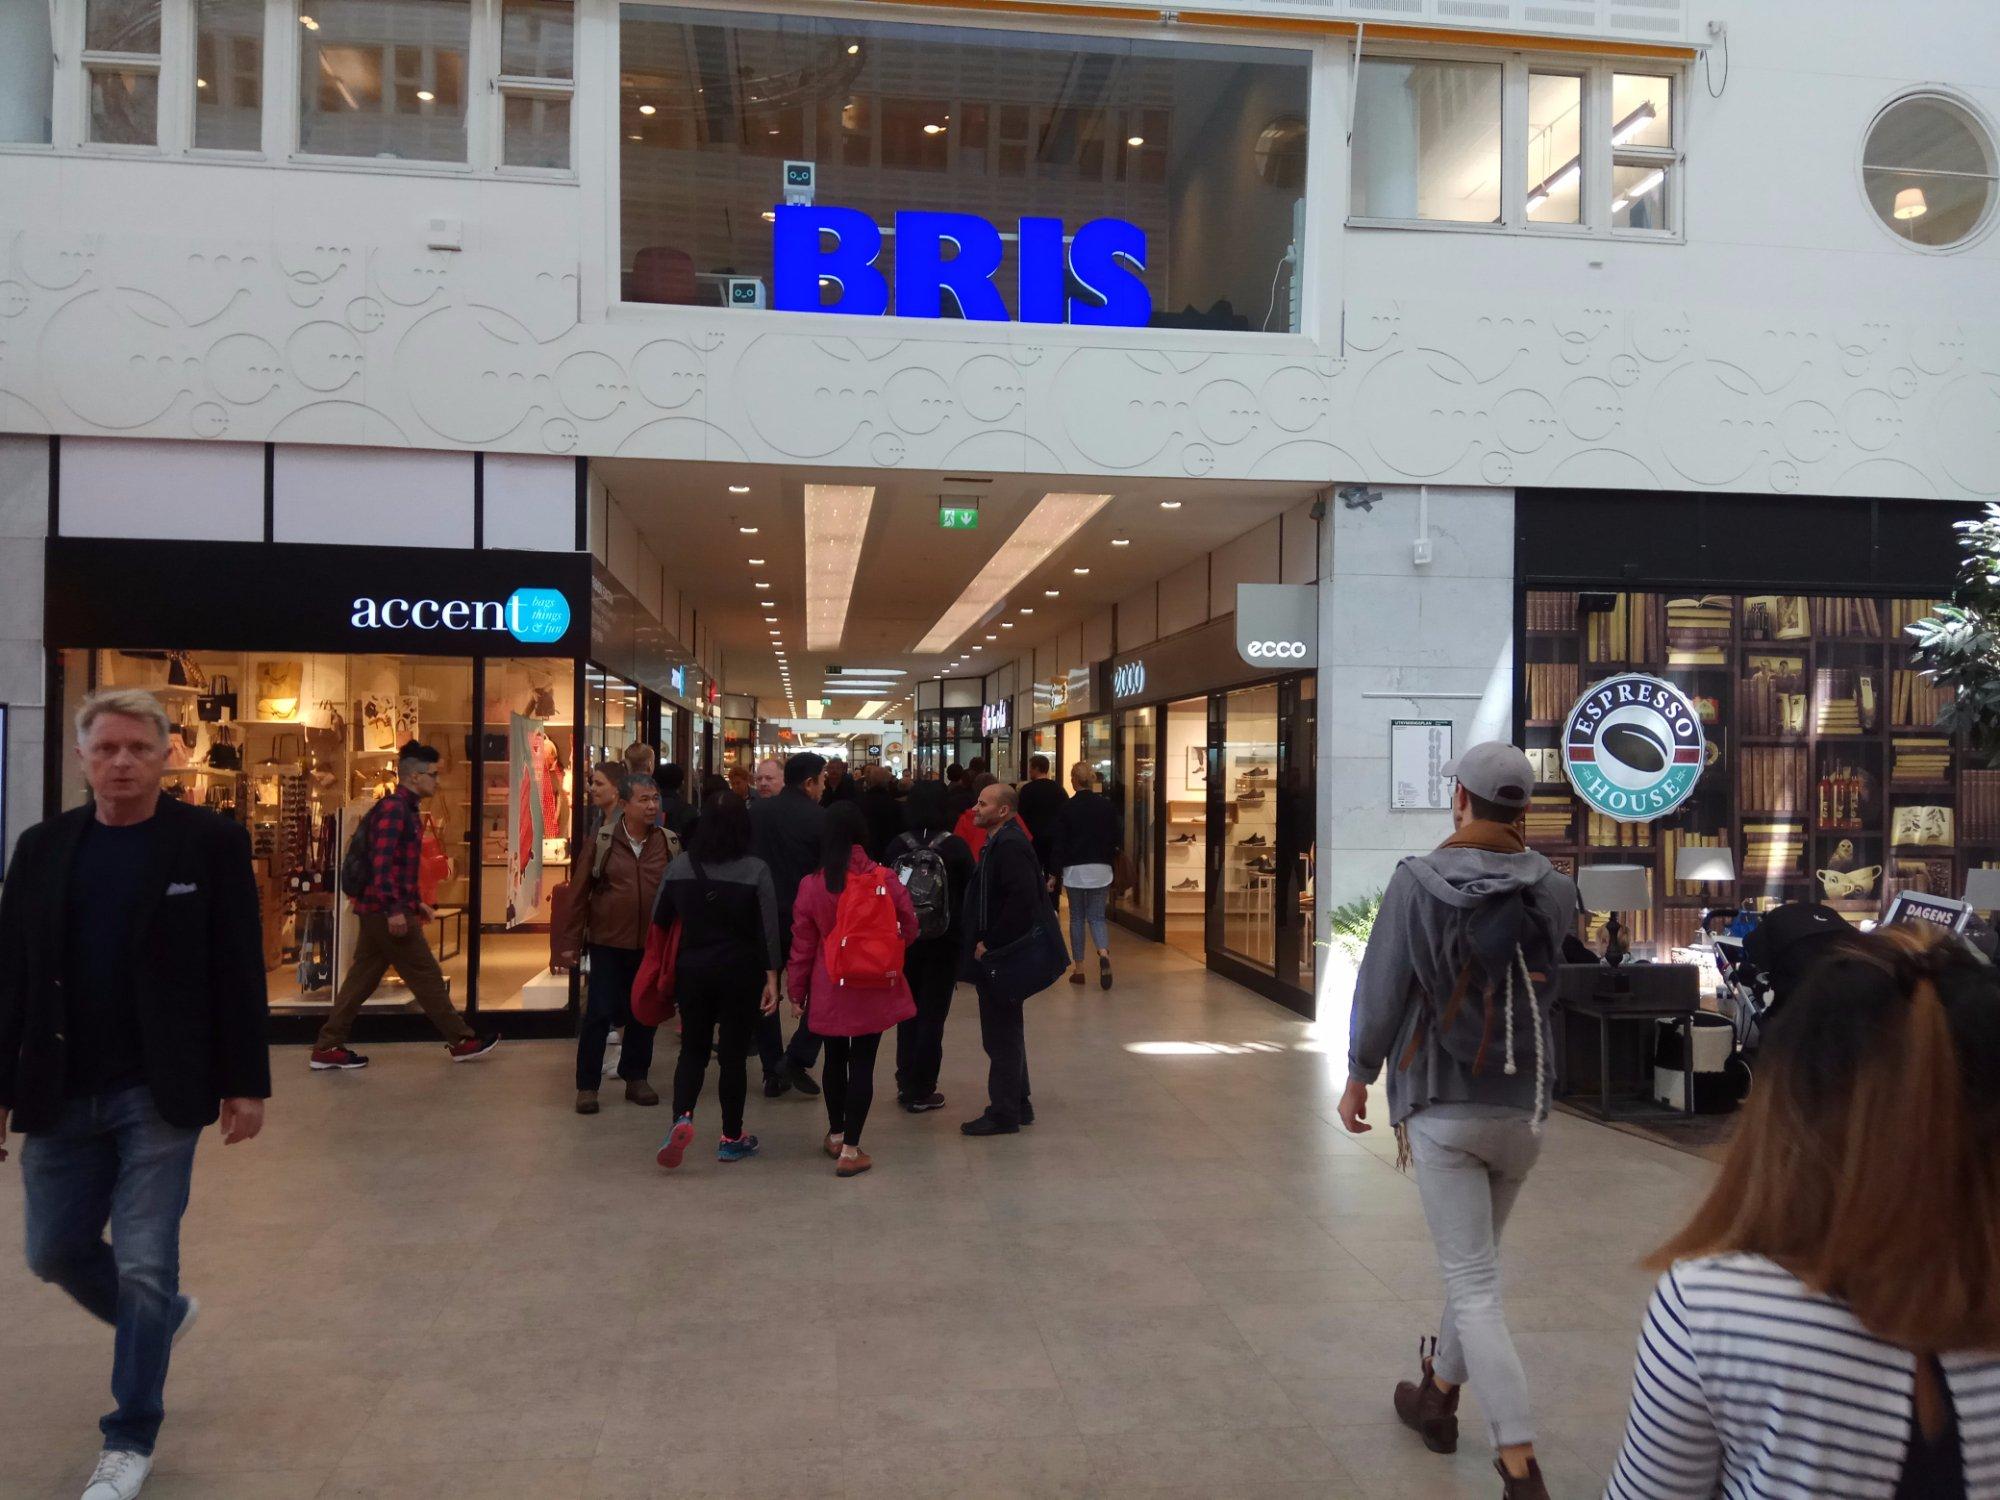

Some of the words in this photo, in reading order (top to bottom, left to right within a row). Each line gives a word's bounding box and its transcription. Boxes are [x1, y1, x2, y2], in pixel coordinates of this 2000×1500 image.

[774, 204, 1152, 327] BRIS
[532, 596, 555, 609] bags
[351, 595, 529, 633] accent
[532, 610, 562, 622] things
[532, 622, 543, 633] &
[543, 623, 562, 635] fun
[1247, 640, 1307, 659] ecco
[1575, 683, 1693, 737] ESPRESSO
[1587, 779, 1680, 812] HOUSE
[1906, 903, 1954, 925] DAGENS
